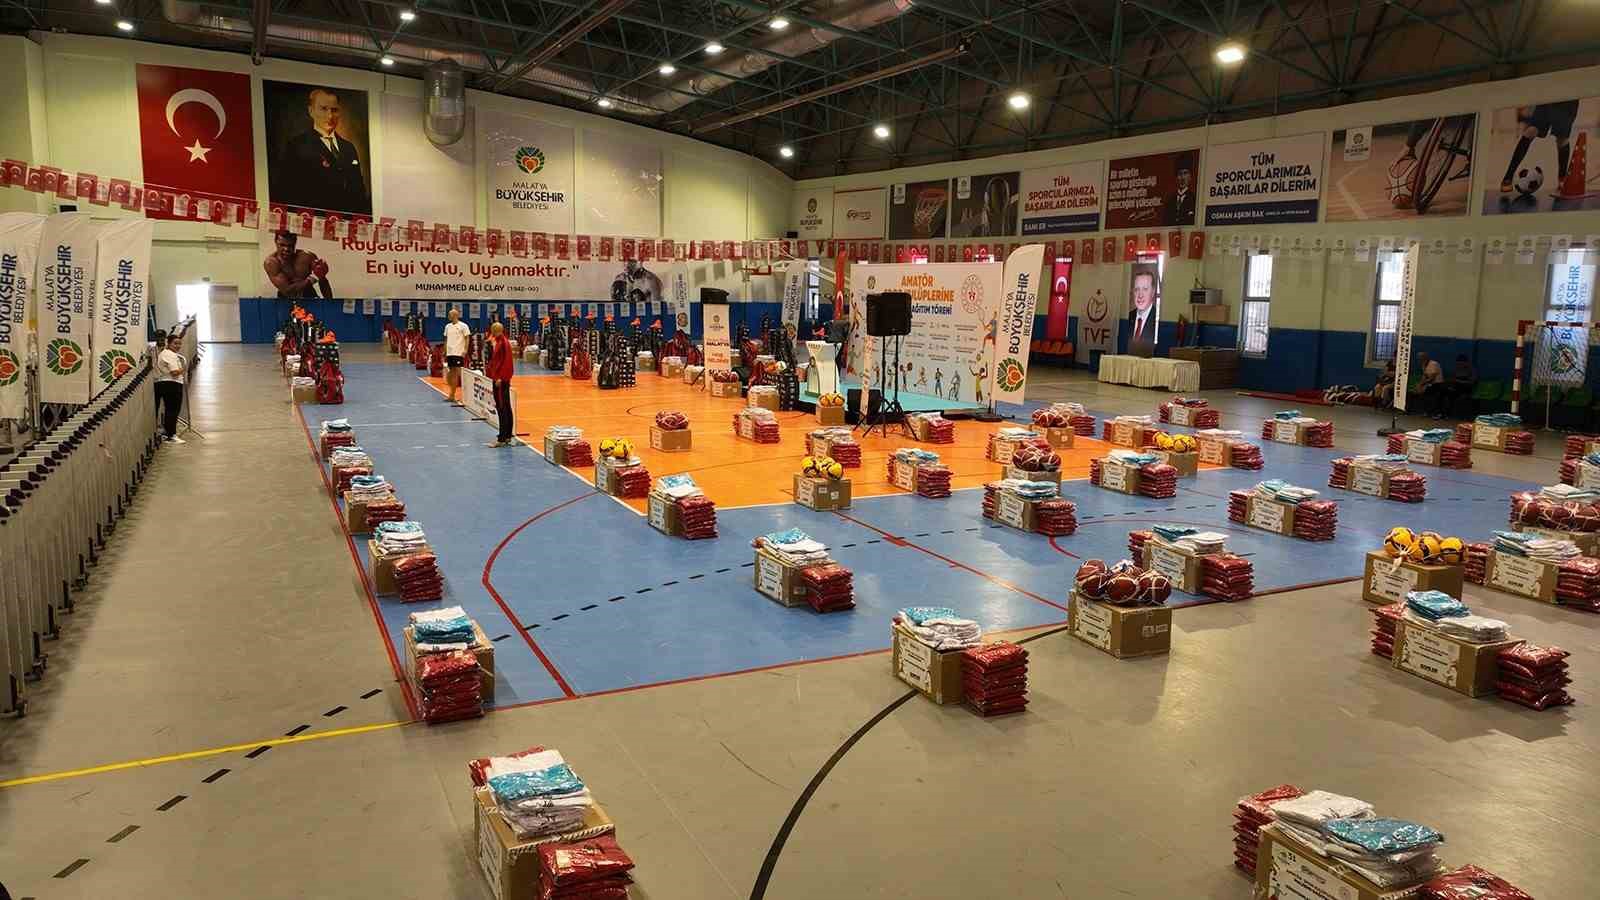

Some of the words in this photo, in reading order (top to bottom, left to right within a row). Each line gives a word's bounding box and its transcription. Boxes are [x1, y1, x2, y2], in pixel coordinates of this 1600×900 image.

[1251, 152, 1274, 166] TÜM
[1054, 176, 1070, 186] TÜM
[1216, 165, 1311, 183] SPORCULARIMIZA
[513, 182, 548, 190] MALATYA
[1029, 185, 1095, 200] SPORCULARIMIZA
[1210, 182, 1269, 199] BAŞARILAR
[1270, 178, 1317, 193] DİLERİM
[496, 189, 565, 203] BÜYÜKŞEHİR
[512, 201, 549, 210] BELEDİYESİ
[366, 260, 388, 275] En
[393, 260, 415, 278] iyi
[420, 261, 464, 277] Yolu,
[469, 263, 580, 279] Uyanmaktır."
[45, 265, 55, 311] MALATYA
[57, 244, 72, 334] BÜYÜKŞEHİR
[415, 283, 467, 292] MUHAMMED
[468, 283, 483, 292] ALİ
[484, 284, 505, 292] CLAY
[901, 273, 934, 287] AMATÖR
[74, 266, 83, 314] BELEDİYESİ
[910, 287, 955, 302] ULÜPLERİNE
[13, 277, 26, 324] BELEDİYESİ
[103, 278, 114, 323] MALATYA
[113, 259, 133, 345] BÜYÜKŞEHİR
[130, 281, 144, 326] BELEDİYESİ
[911, 303, 931, 314] AĞITIM
[1002, 291, 1015, 333] MALATYA
[1009, 272, 1030, 354] BÜYÜKŞEHİR
[1083, 328, 1110, 345] TVF
